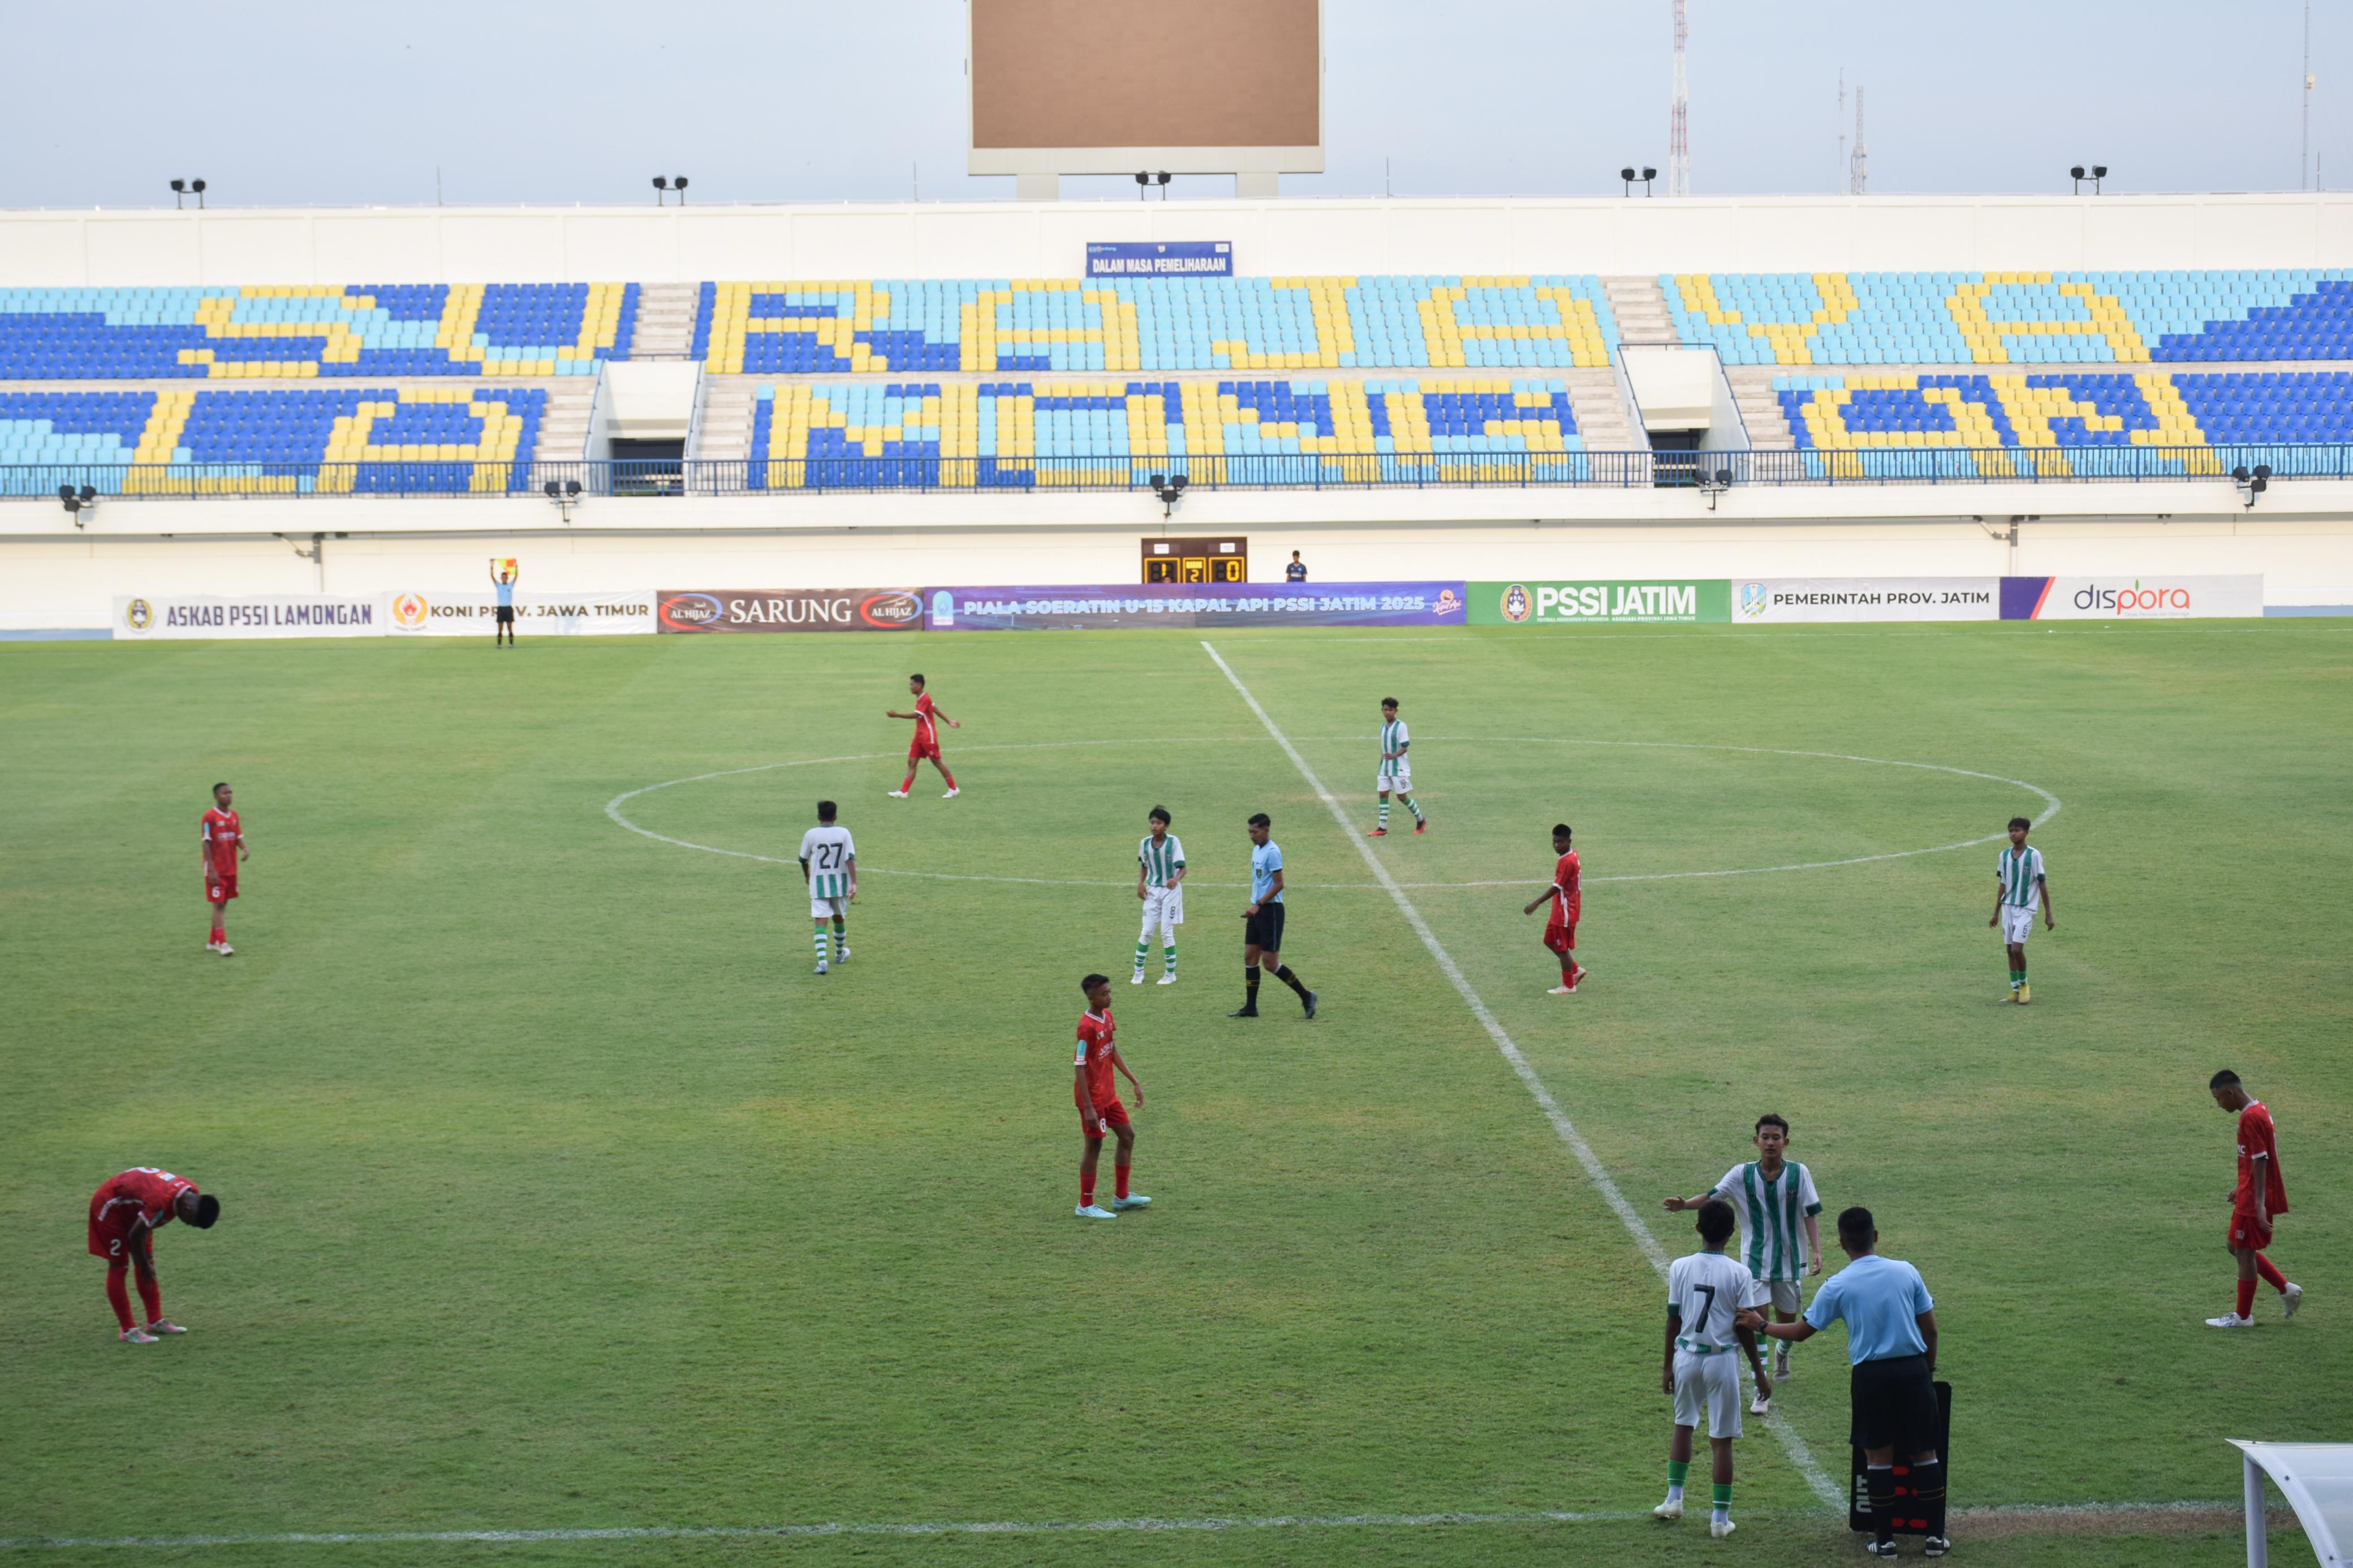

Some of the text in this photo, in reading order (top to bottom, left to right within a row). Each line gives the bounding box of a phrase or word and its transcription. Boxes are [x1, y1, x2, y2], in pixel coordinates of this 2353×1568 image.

[1093, 258, 1226, 273] DALAM MASA PEMELIHARAAN
[1226, 561, 1239, 581] 0
[964, 597, 1425, 615] PIALA SOERATIN U-15 KAPAL API PSSI JATIM 2025
[1537, 586, 1696, 616] PSSI JATIM
[1774, 592, 1989, 605] PEMERINTAH PROV. JATIM
[2074, 584, 2190, 615] dispora
[167, 606, 223, 626] ASKAB
[230, 606, 268, 625] PSSI
[274, 604, 372, 625] LAMONGAN
[430, 604, 649, 617] KONI PRV. JAWA TIMUR
[671, 608, 711, 620] AL HIJAZ
[730, 599, 852, 623] SARUNG
[872, 607, 911, 619] AL HIJAZ
[817, 843, 843, 869] 27
[1170, 906, 1175, 916] 8
[2022, 925, 2028, 935] 6
[110, 1239, 121, 1256] 2
[1694, 1284, 1715, 1333] 7
